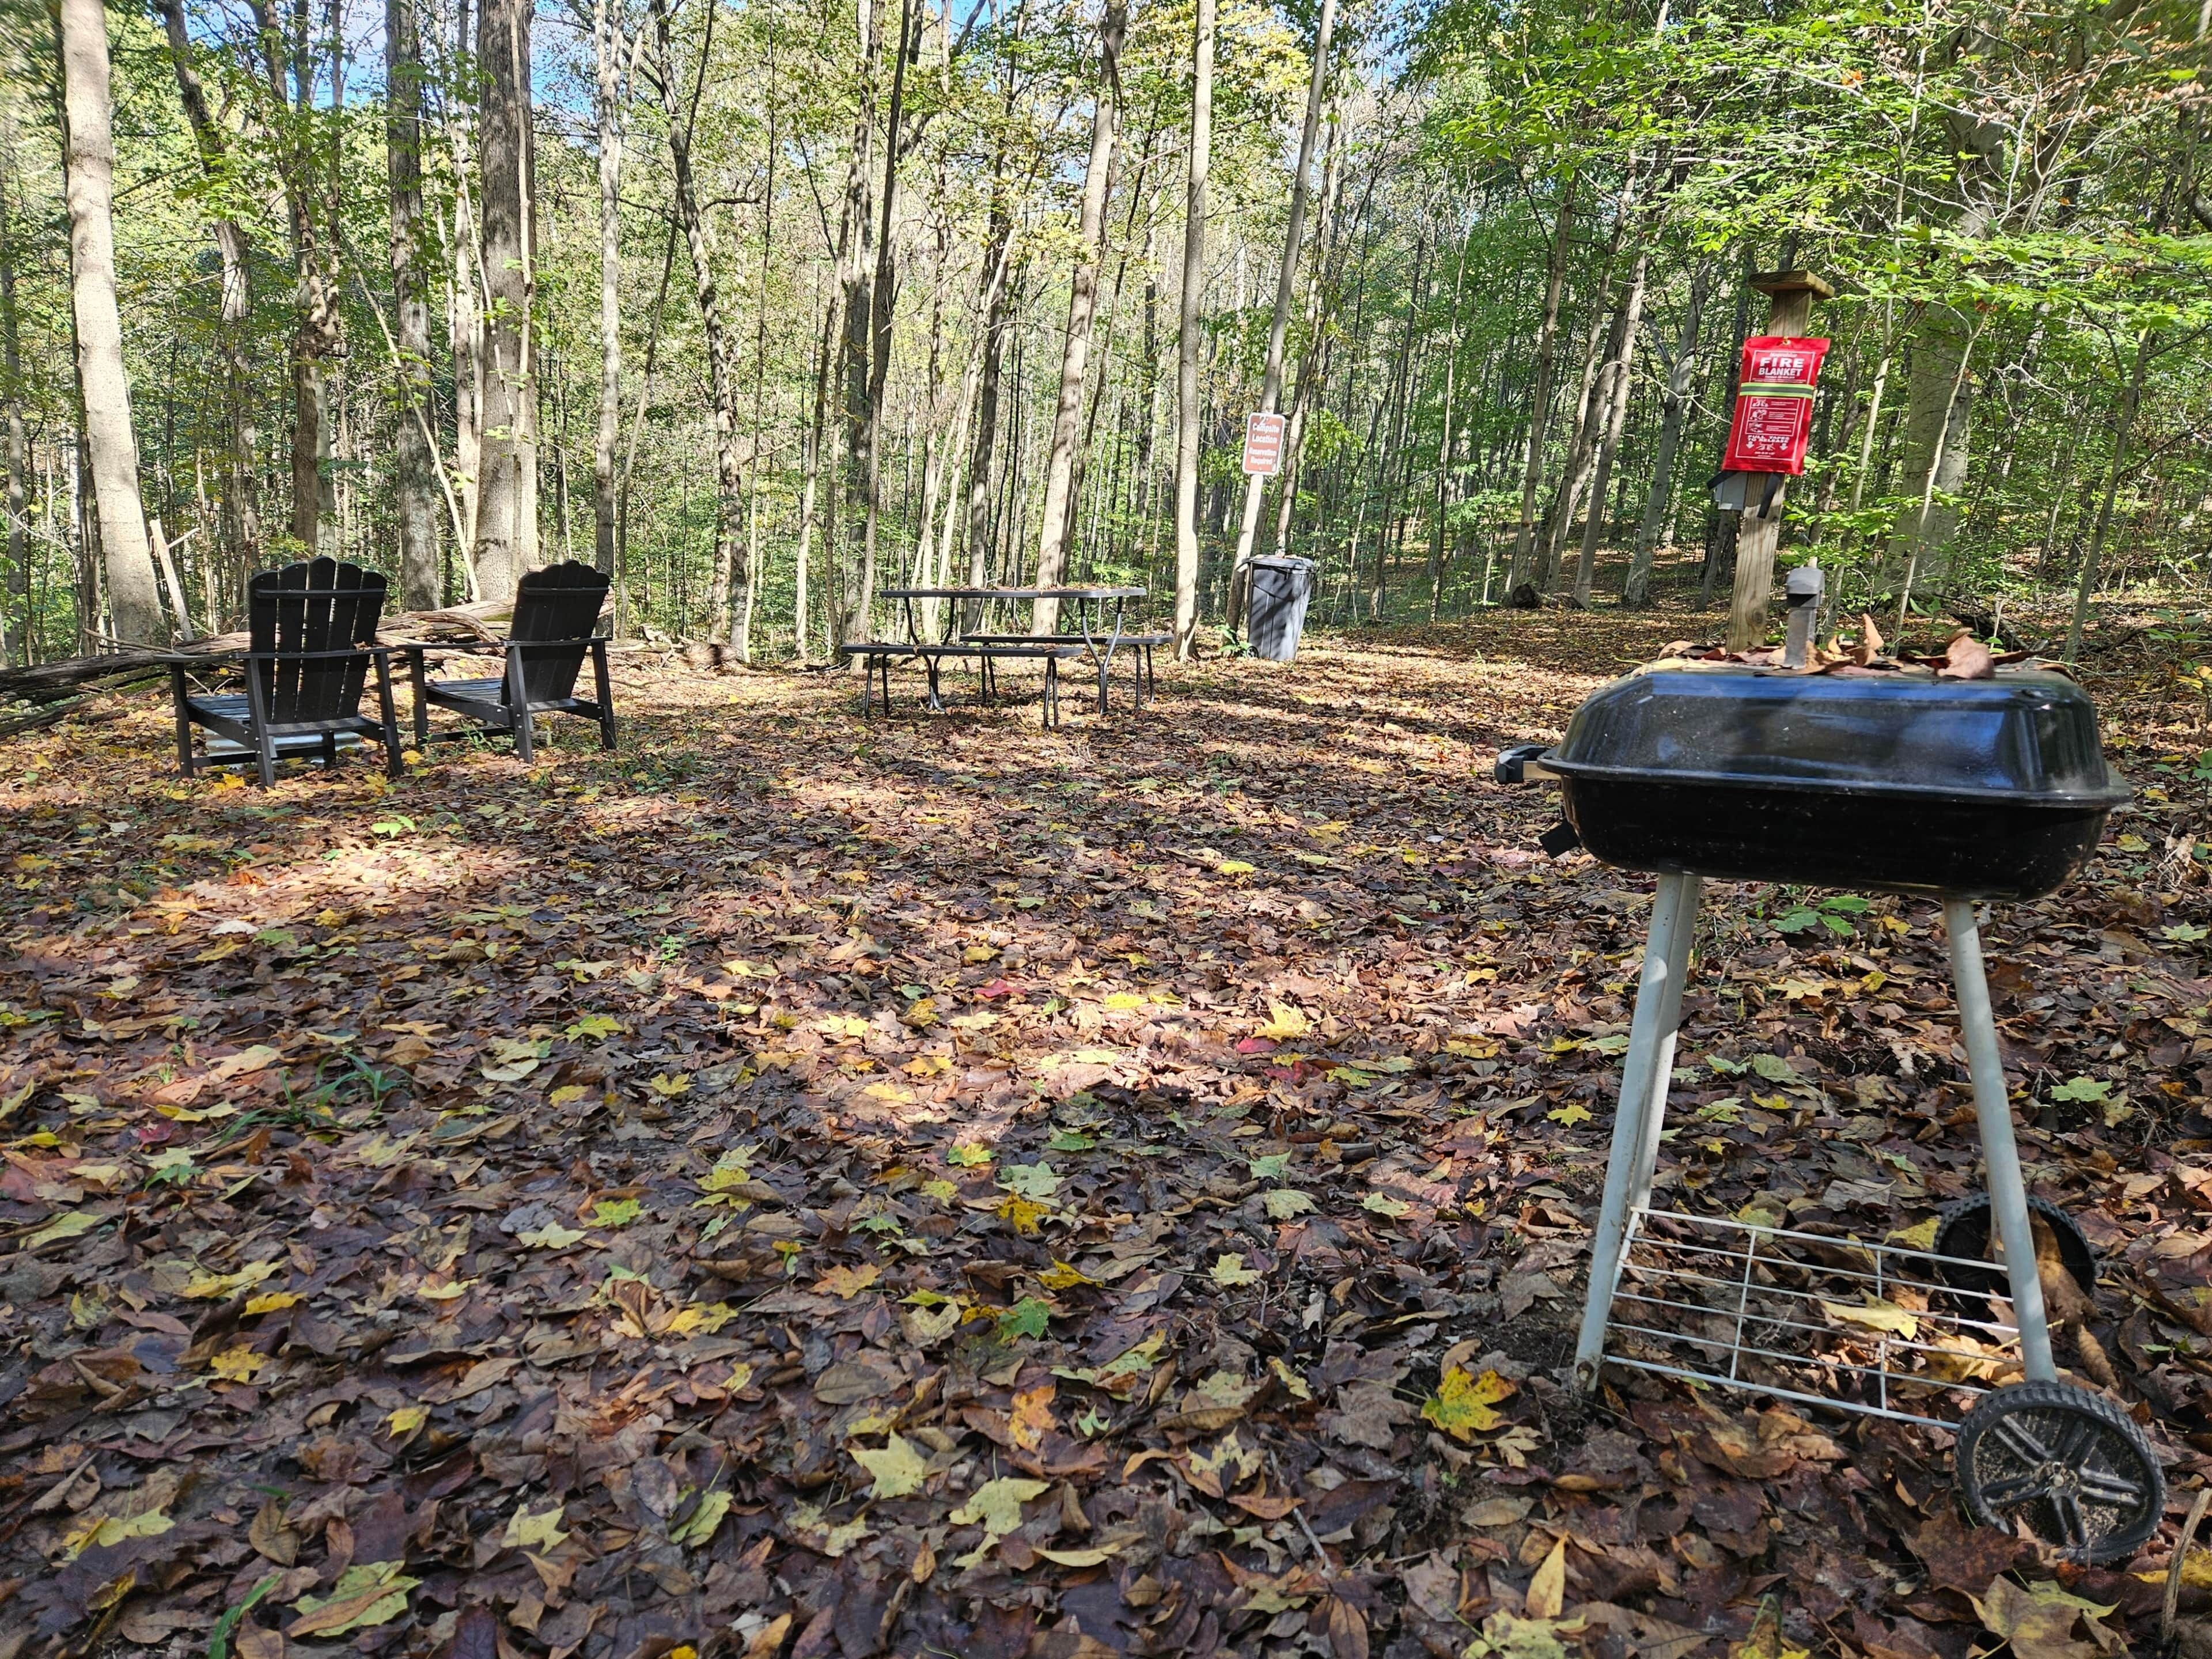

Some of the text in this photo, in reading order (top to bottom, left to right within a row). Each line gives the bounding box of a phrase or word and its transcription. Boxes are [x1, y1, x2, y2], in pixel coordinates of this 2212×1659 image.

[1760, 357, 1805, 368] FIRE
[1759, 368, 1802, 377] BLANKET
[1252, 423, 1279, 434] Campsite
[1252, 434, 1278, 444] Location
[1250, 456, 1273, 464] Required
